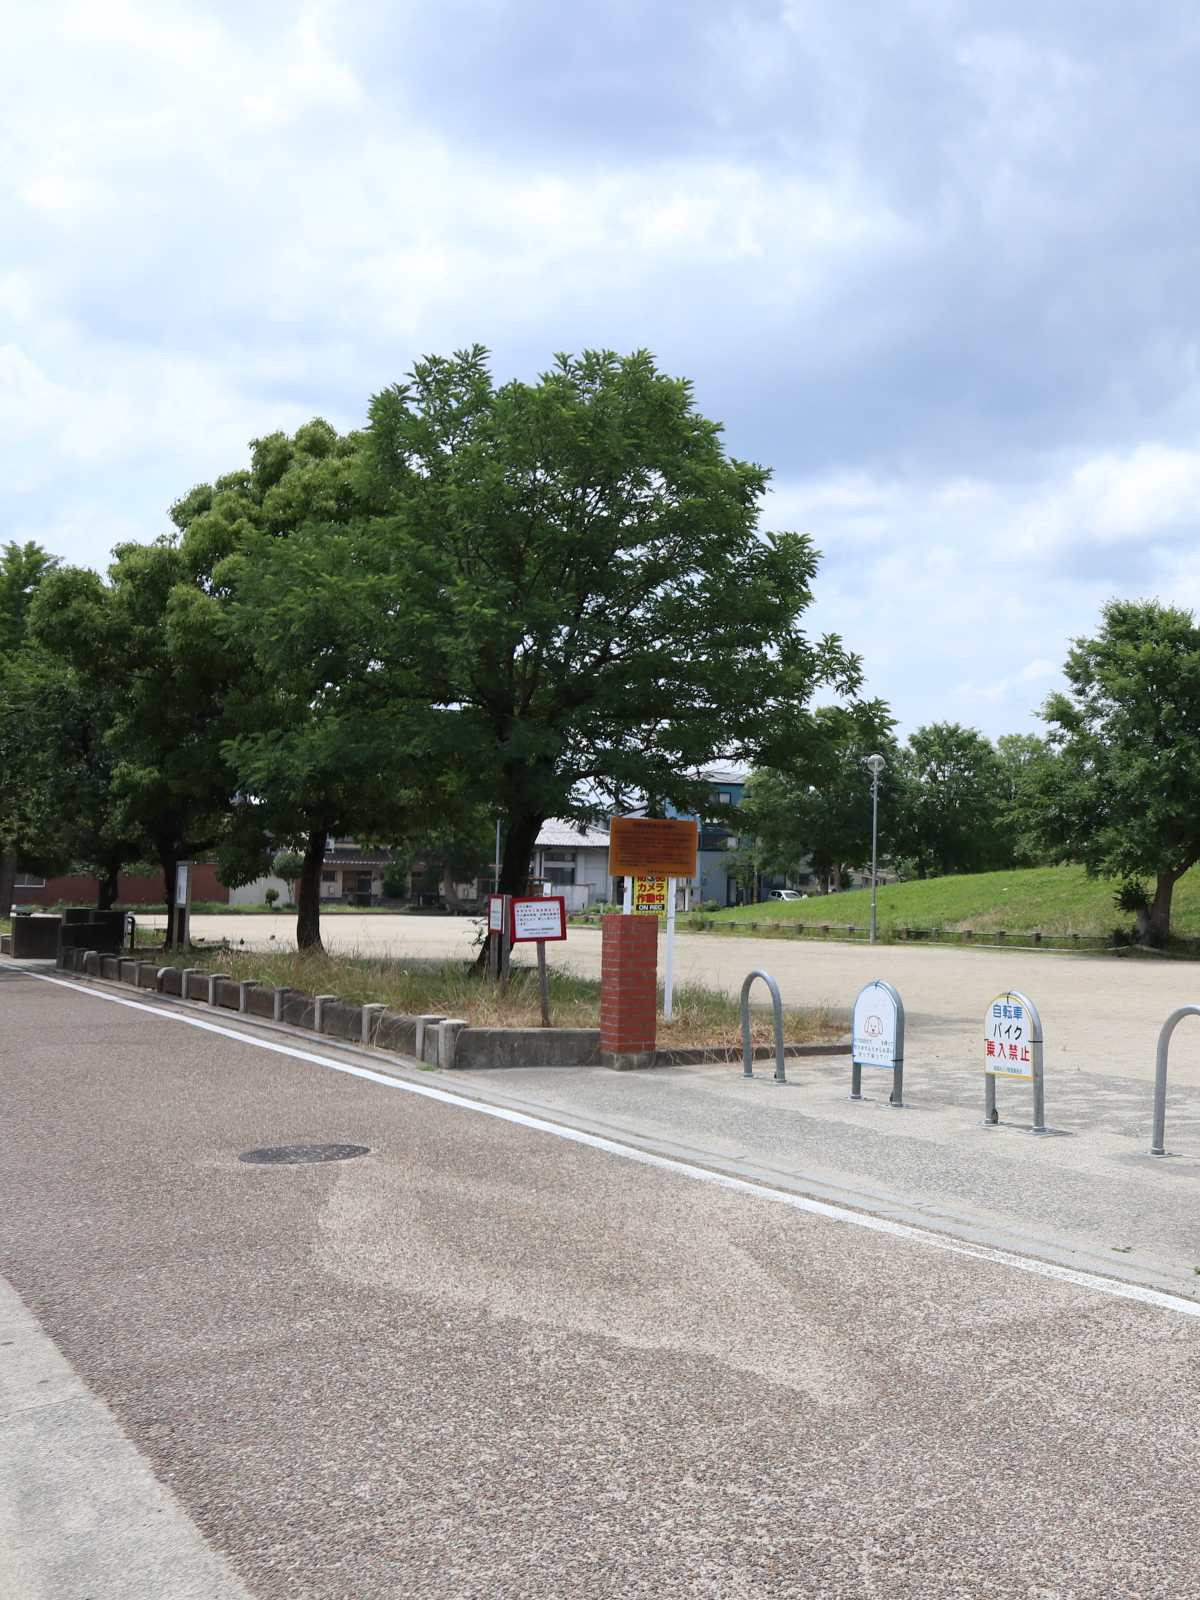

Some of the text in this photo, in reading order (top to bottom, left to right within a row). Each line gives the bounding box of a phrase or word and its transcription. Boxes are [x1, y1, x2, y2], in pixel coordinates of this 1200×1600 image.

[637, 883, 665, 892] カメラ
[637, 893, 665, 903] 作動中
[993, 1004, 1023, 1020] 自転車
[993, 1022, 1022, 1040] バイク
[986, 1040, 1030, 1062] 乗入禁止
